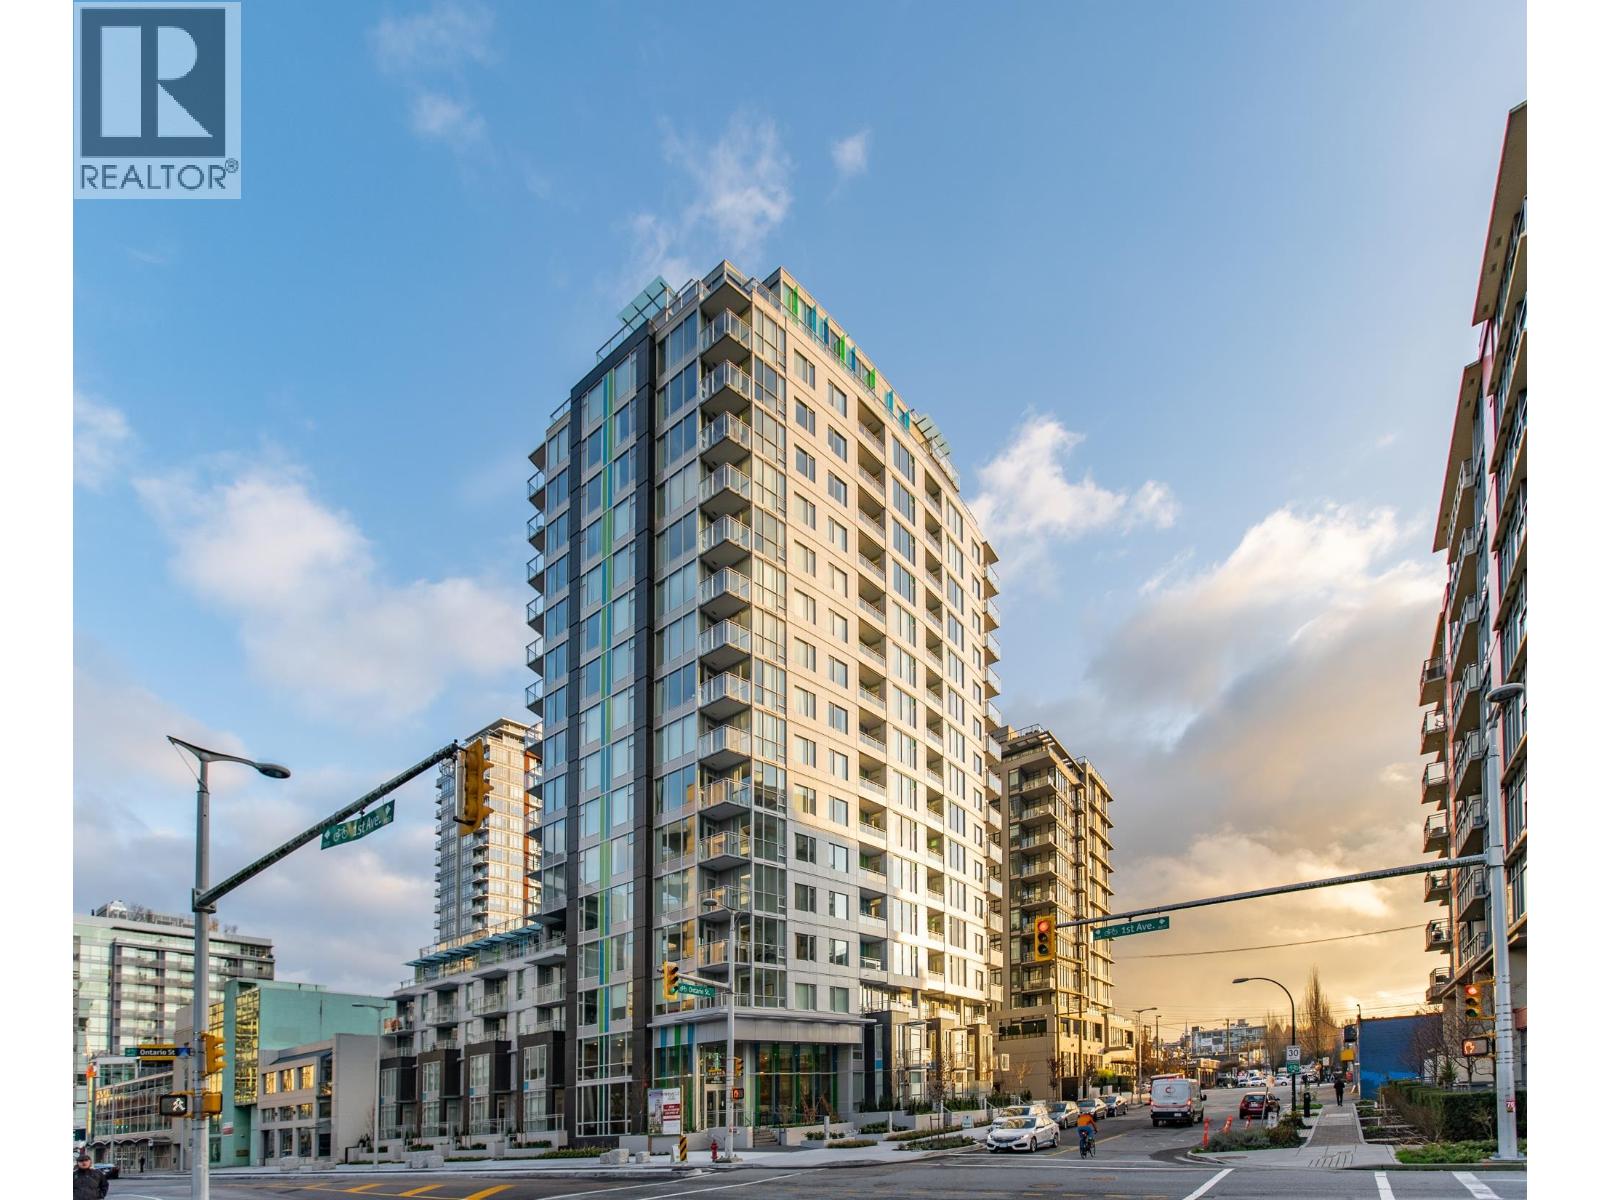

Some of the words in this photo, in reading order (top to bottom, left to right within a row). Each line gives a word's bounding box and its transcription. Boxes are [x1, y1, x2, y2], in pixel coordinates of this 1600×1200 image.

[352, 821, 366, 837] 1st
[365, 814, 382, 831] Ave.
[1121, 924, 1135, 934] 1st
[1136, 922, 1156, 932] Ave.
[688, 986, 704, 995] Ontario
[1288, 1049, 1299, 1057] 30
